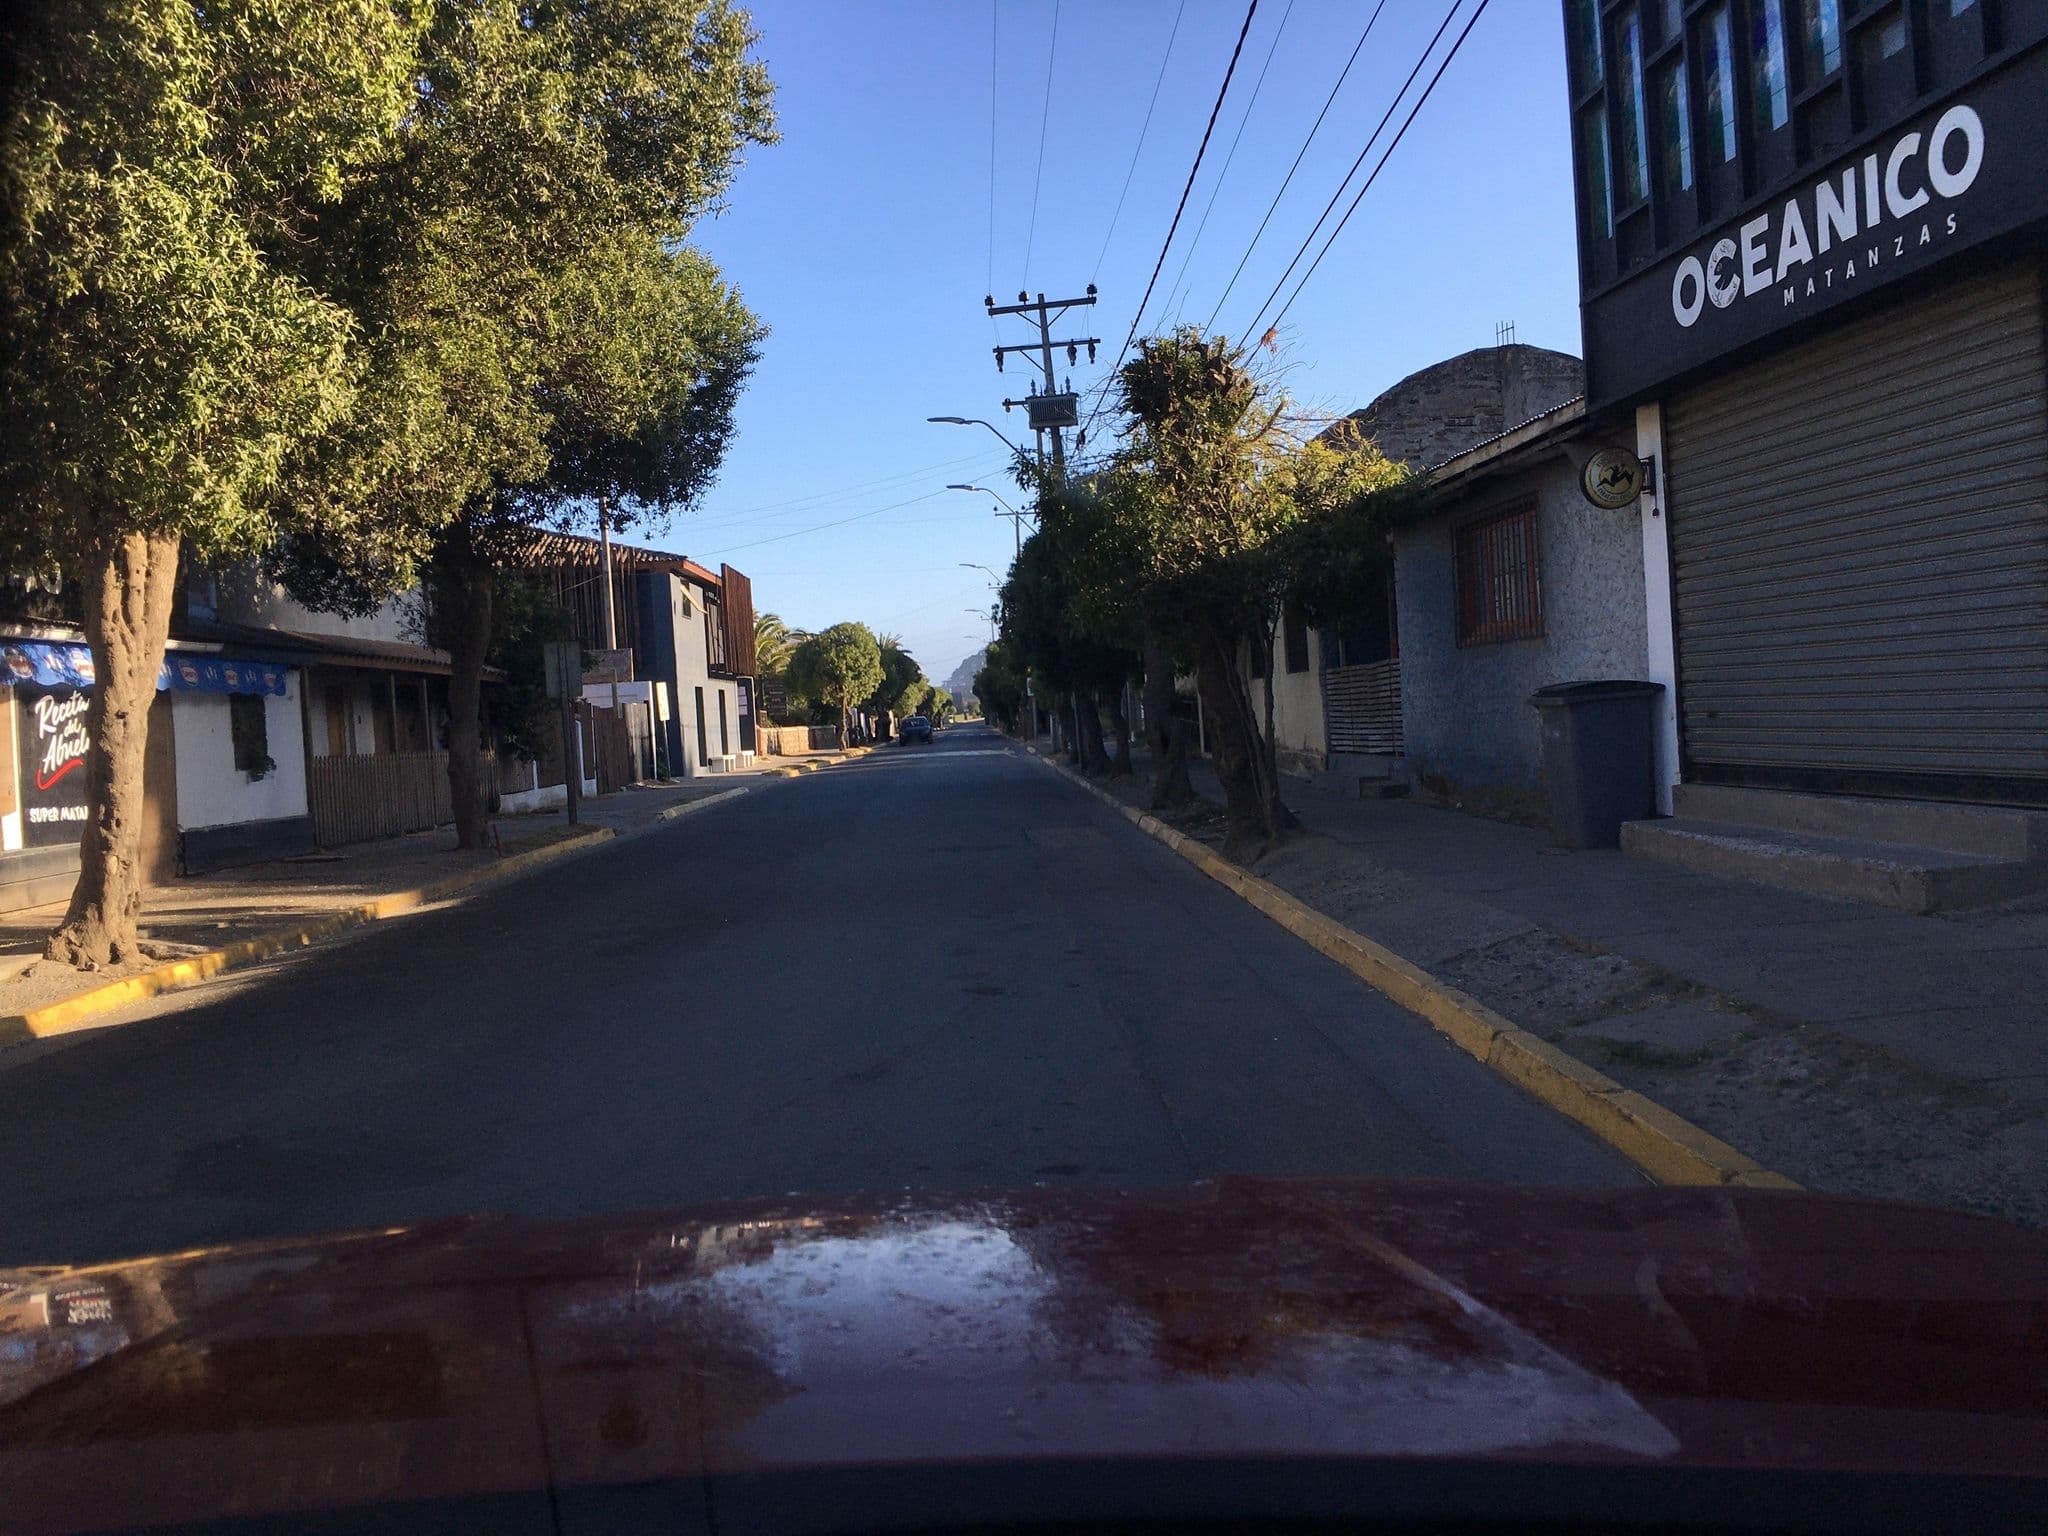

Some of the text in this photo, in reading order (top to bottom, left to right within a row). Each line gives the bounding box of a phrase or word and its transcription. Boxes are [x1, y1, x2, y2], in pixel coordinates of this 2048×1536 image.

[1672, 105, 1984, 327] OCEANICO
[1783, 212, 1957, 306] MATANZAS
[34, 690, 90, 739] Receta
[64, 717, 82, 737] del
[29, 806, 59, 823] SUPER
